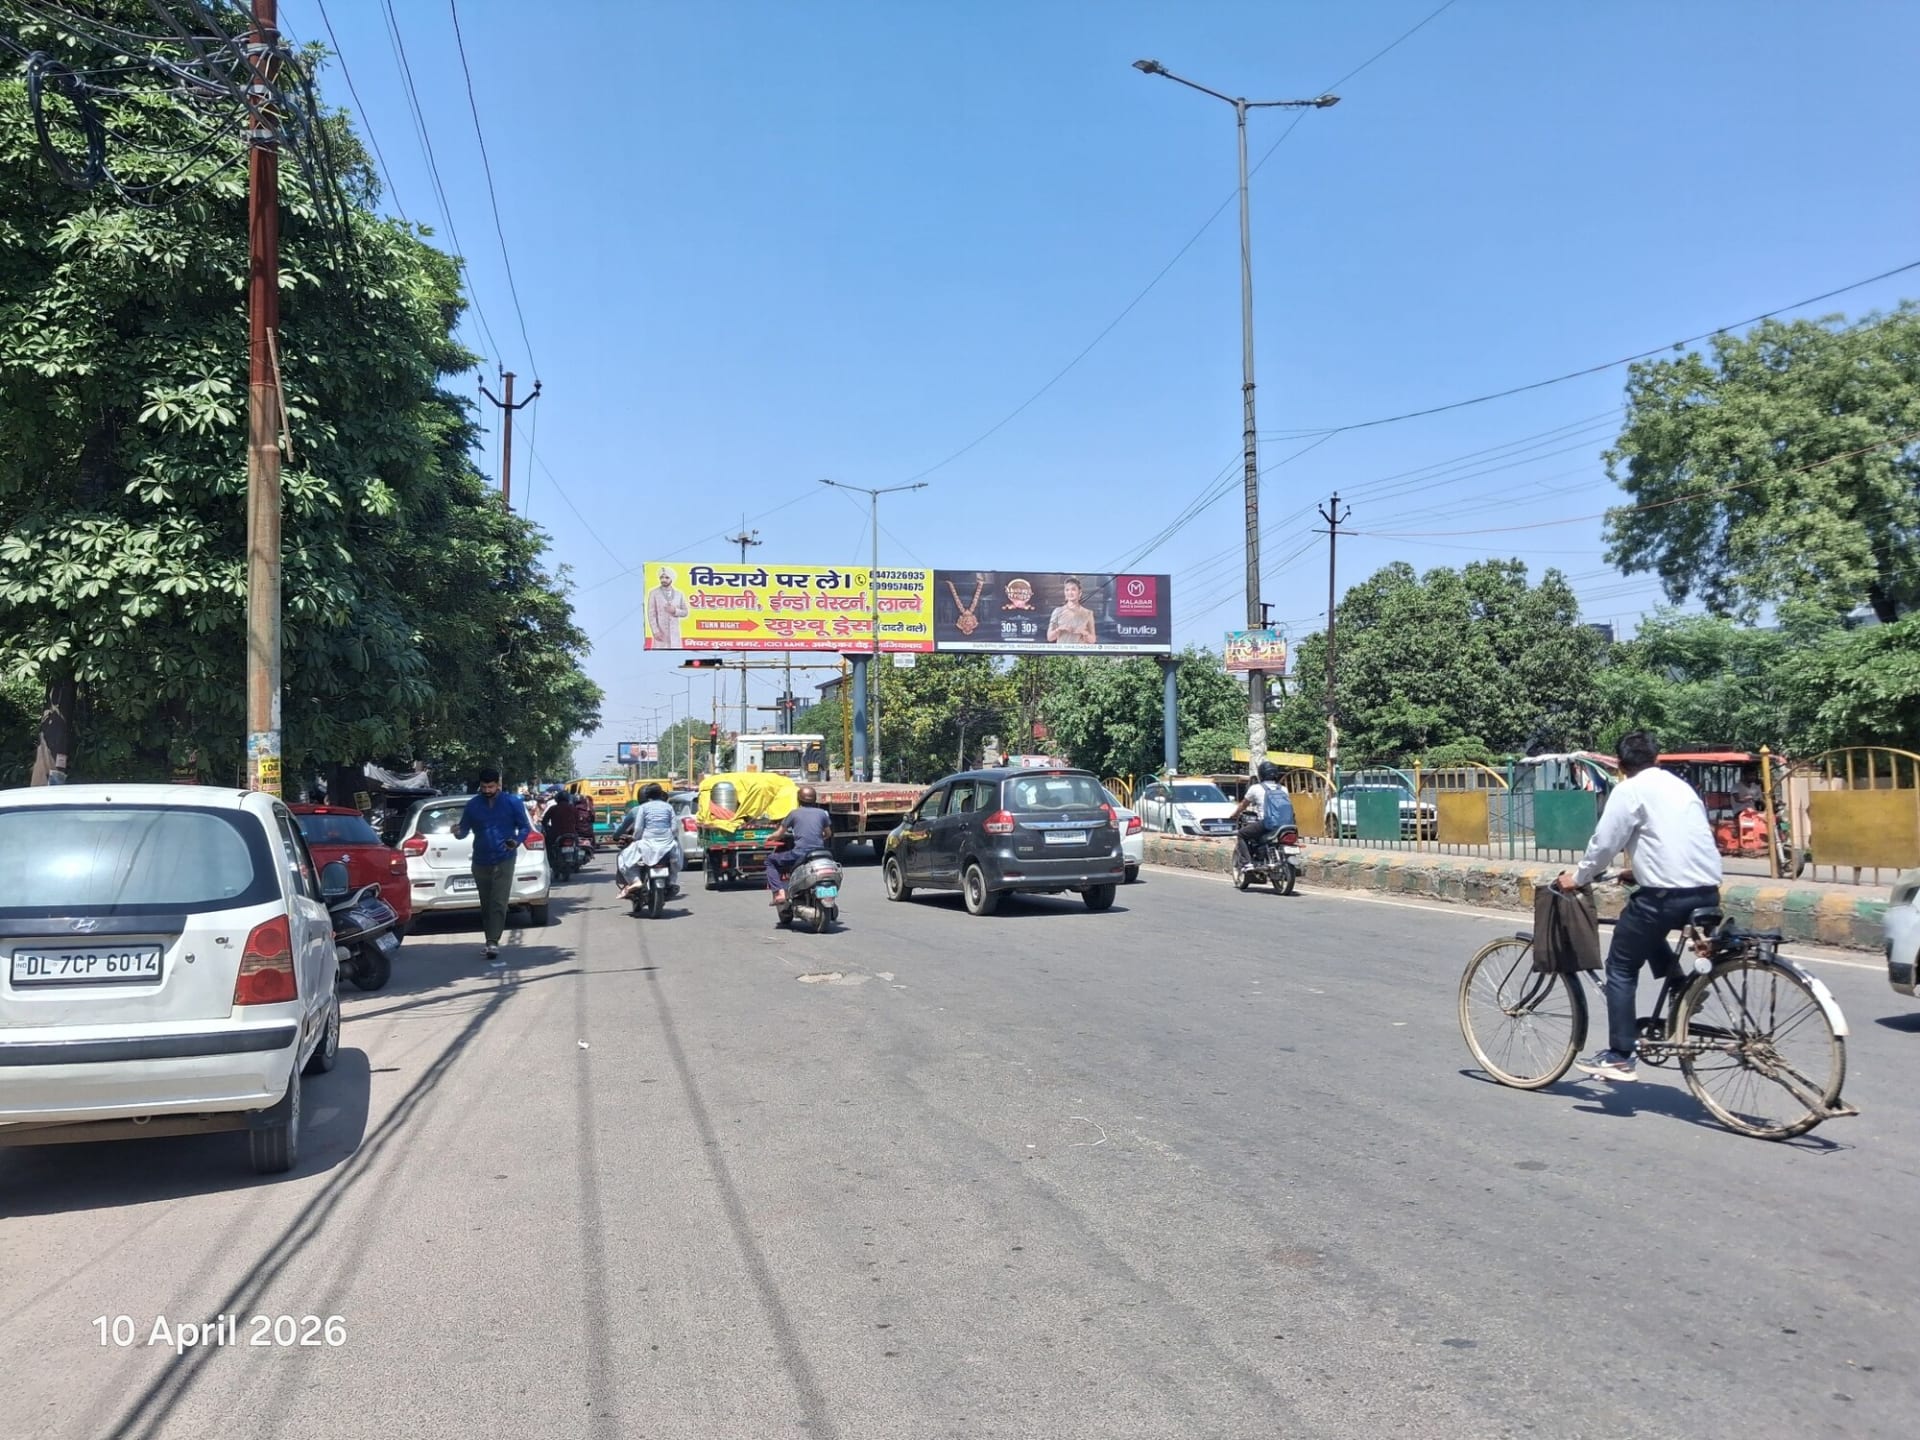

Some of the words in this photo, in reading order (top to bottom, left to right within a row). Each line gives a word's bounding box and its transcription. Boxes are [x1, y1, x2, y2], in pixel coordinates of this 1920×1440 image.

[689, 566, 769, 587] किराये
[775, 573, 811, 588] पर
[689, 589, 763, 611] शेरवानी,
[720, 621, 741, 629] RIGHT
[27, 956, 51, 975] DL
[59, 955, 97, 975] 7CP
[106, 953, 157, 972] 6014
